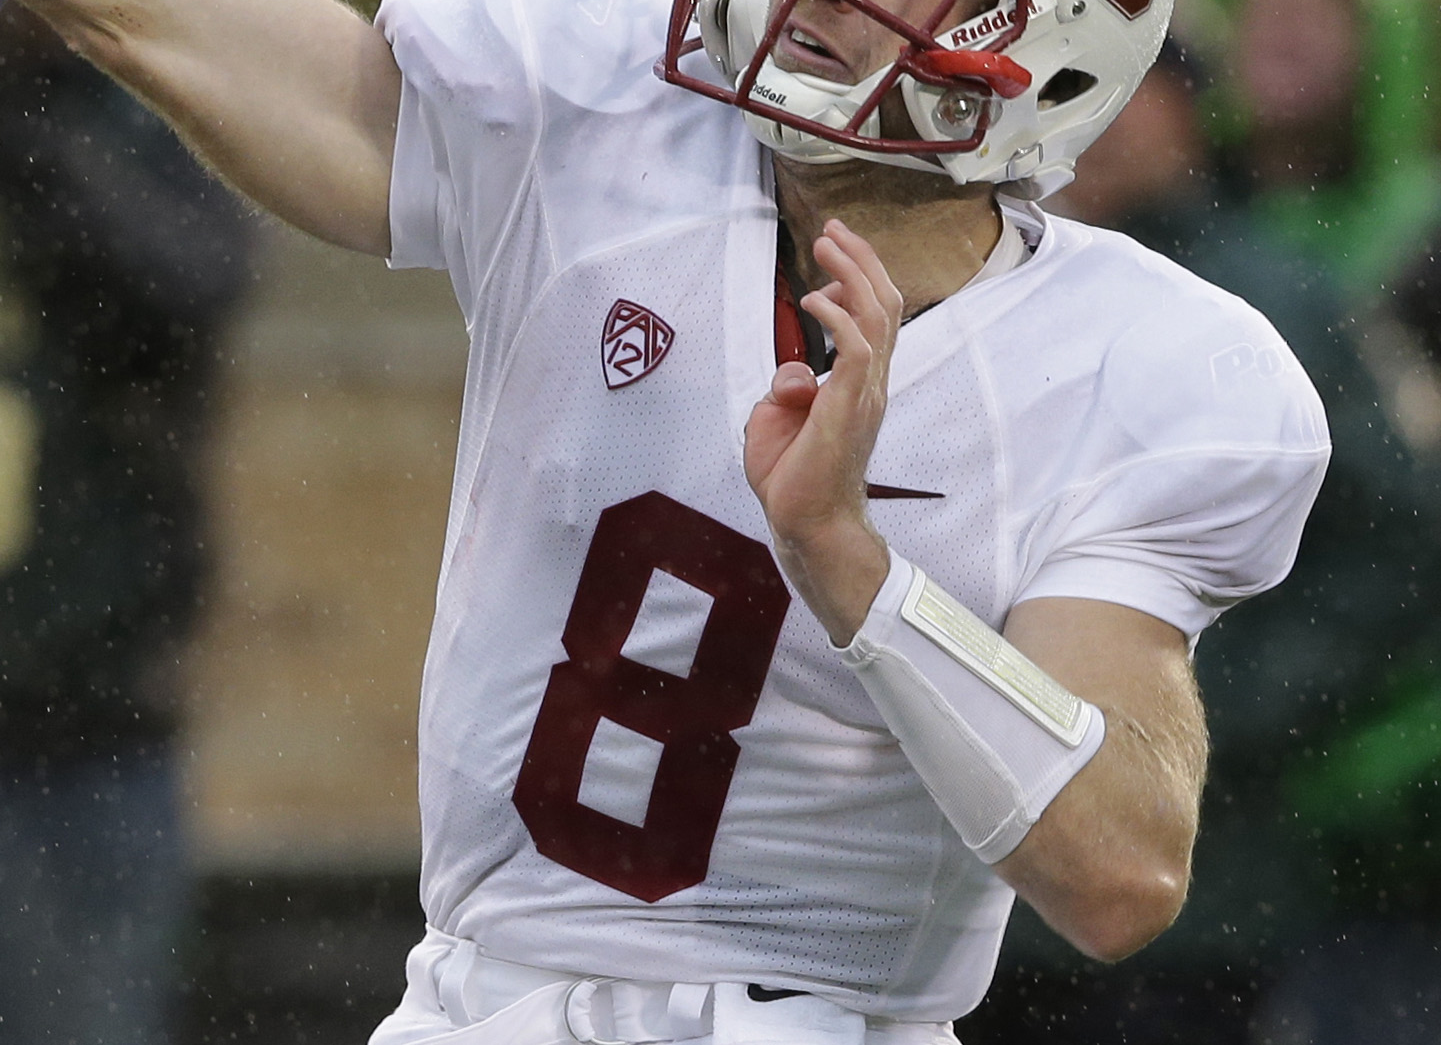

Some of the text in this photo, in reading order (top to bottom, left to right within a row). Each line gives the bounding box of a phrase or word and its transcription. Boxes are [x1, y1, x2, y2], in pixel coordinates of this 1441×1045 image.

[752, 80, 787, 106] iddell
[605, 303, 670, 369] PAC
[606, 338, 644, 378] 12
[511, 489, 791, 904] 8
